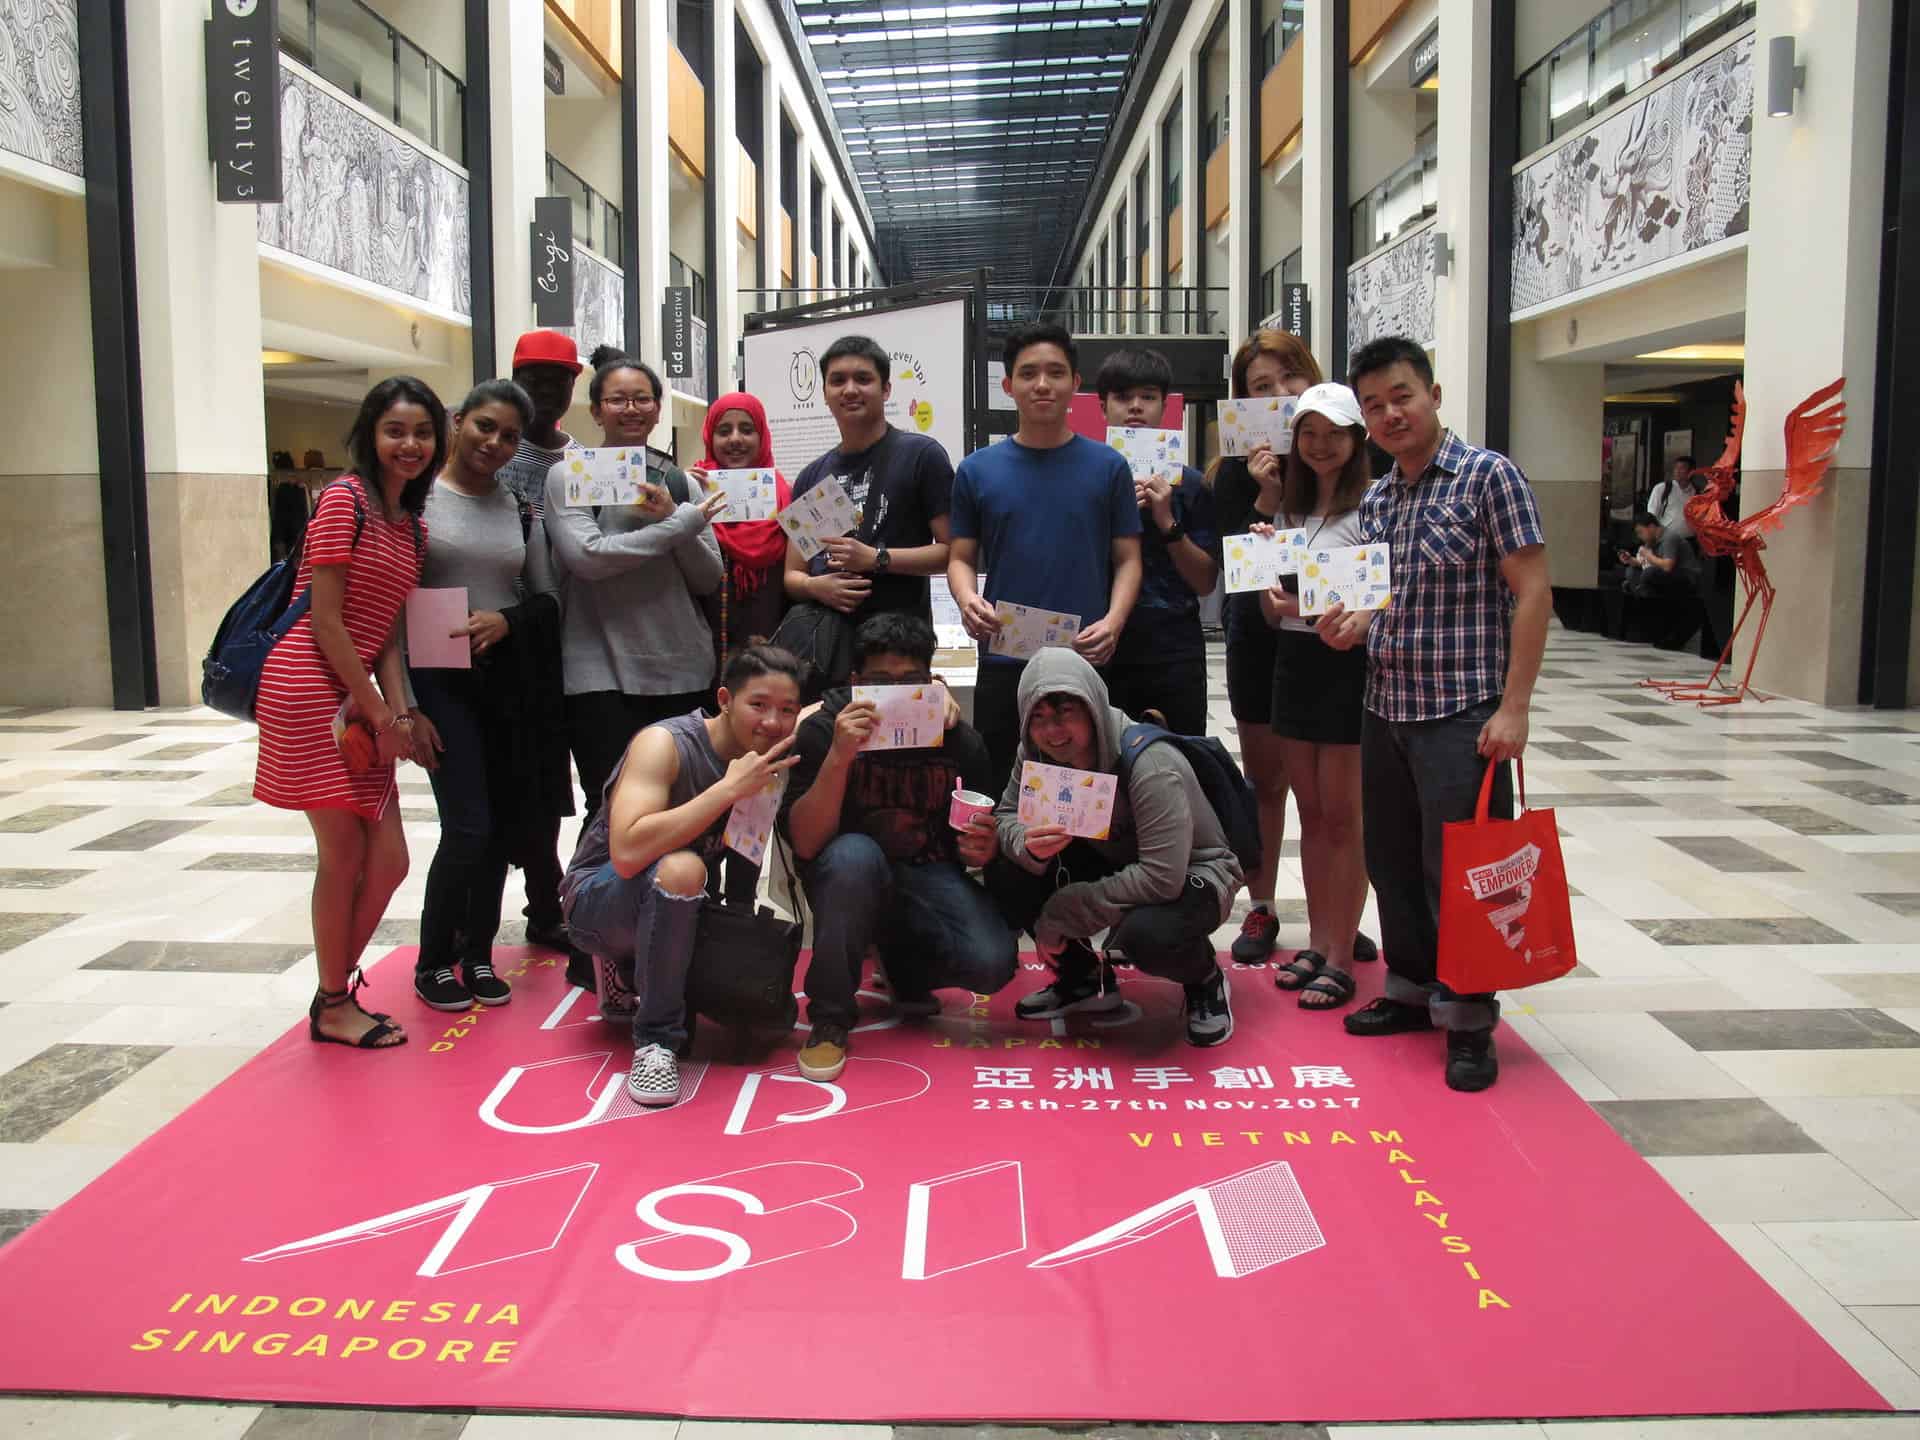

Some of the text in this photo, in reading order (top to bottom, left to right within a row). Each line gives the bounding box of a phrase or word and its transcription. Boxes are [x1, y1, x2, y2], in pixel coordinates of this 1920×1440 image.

[1289, 287, 1302, 337] Sunrise
[671, 290, 684, 374] d.d COLLECTIVE
[429, 958, 537, 1052] THLAND
[930, 1037, 1102, 1050] JAPAN
[972, 1065, 1356, 1090] 亞洲手創展
[972, 1096, 1362, 1112] 23th-27th Nov.2017
[1128, 1130, 1403, 1147] VIETNAM
[1368, 1130, 1512, 1309] MALAYSIA
[168, 1293, 520, 1325] INDONESIA
[131, 1329, 518, 1363] SINGAPORE
